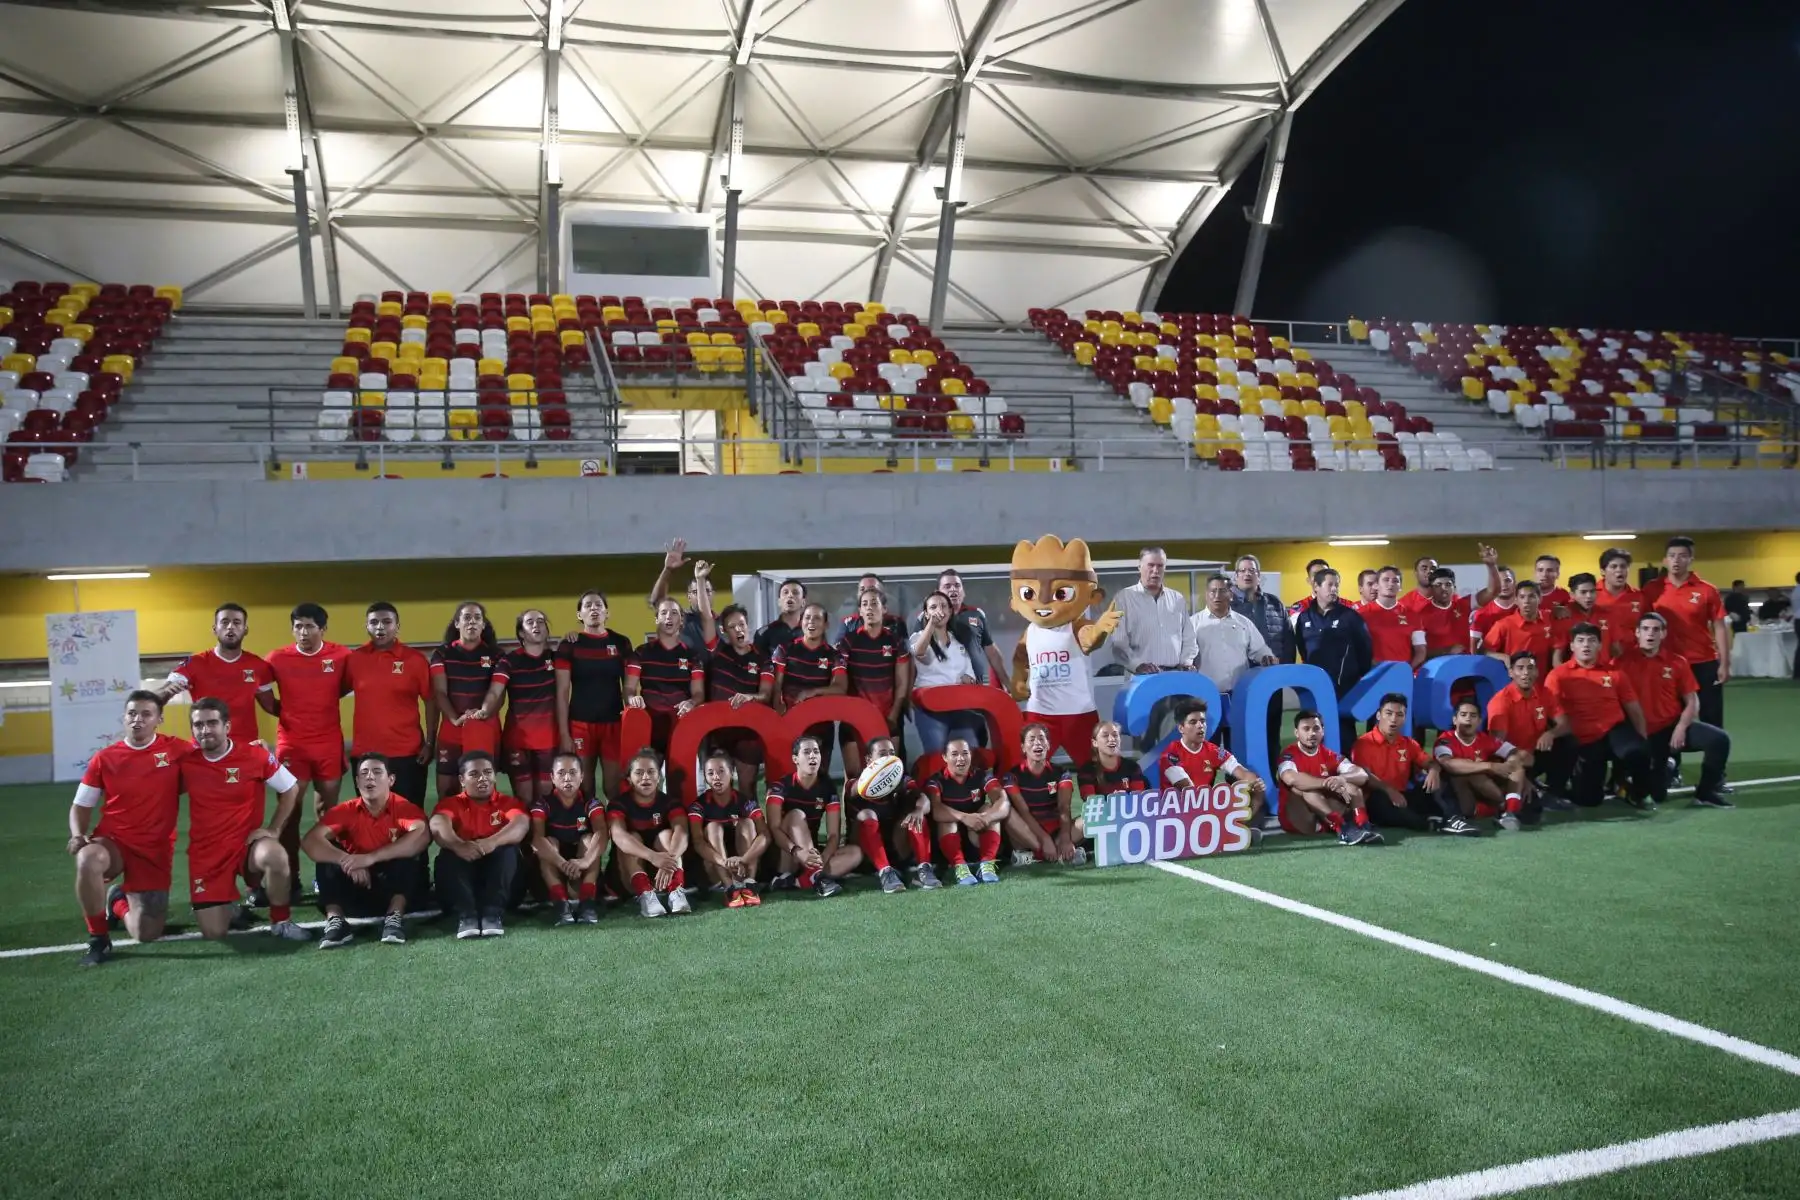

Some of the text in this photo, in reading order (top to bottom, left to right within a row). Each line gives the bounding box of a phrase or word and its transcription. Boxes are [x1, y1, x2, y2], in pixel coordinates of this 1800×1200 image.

[1031, 664, 1071, 680] 2019
[1114, 654, 1513, 816] 2019
[870, 765, 902, 796] GILBERT
[1085, 782, 1250, 822] #JUGAMOS
[1086, 809, 1250, 867] TODOS
